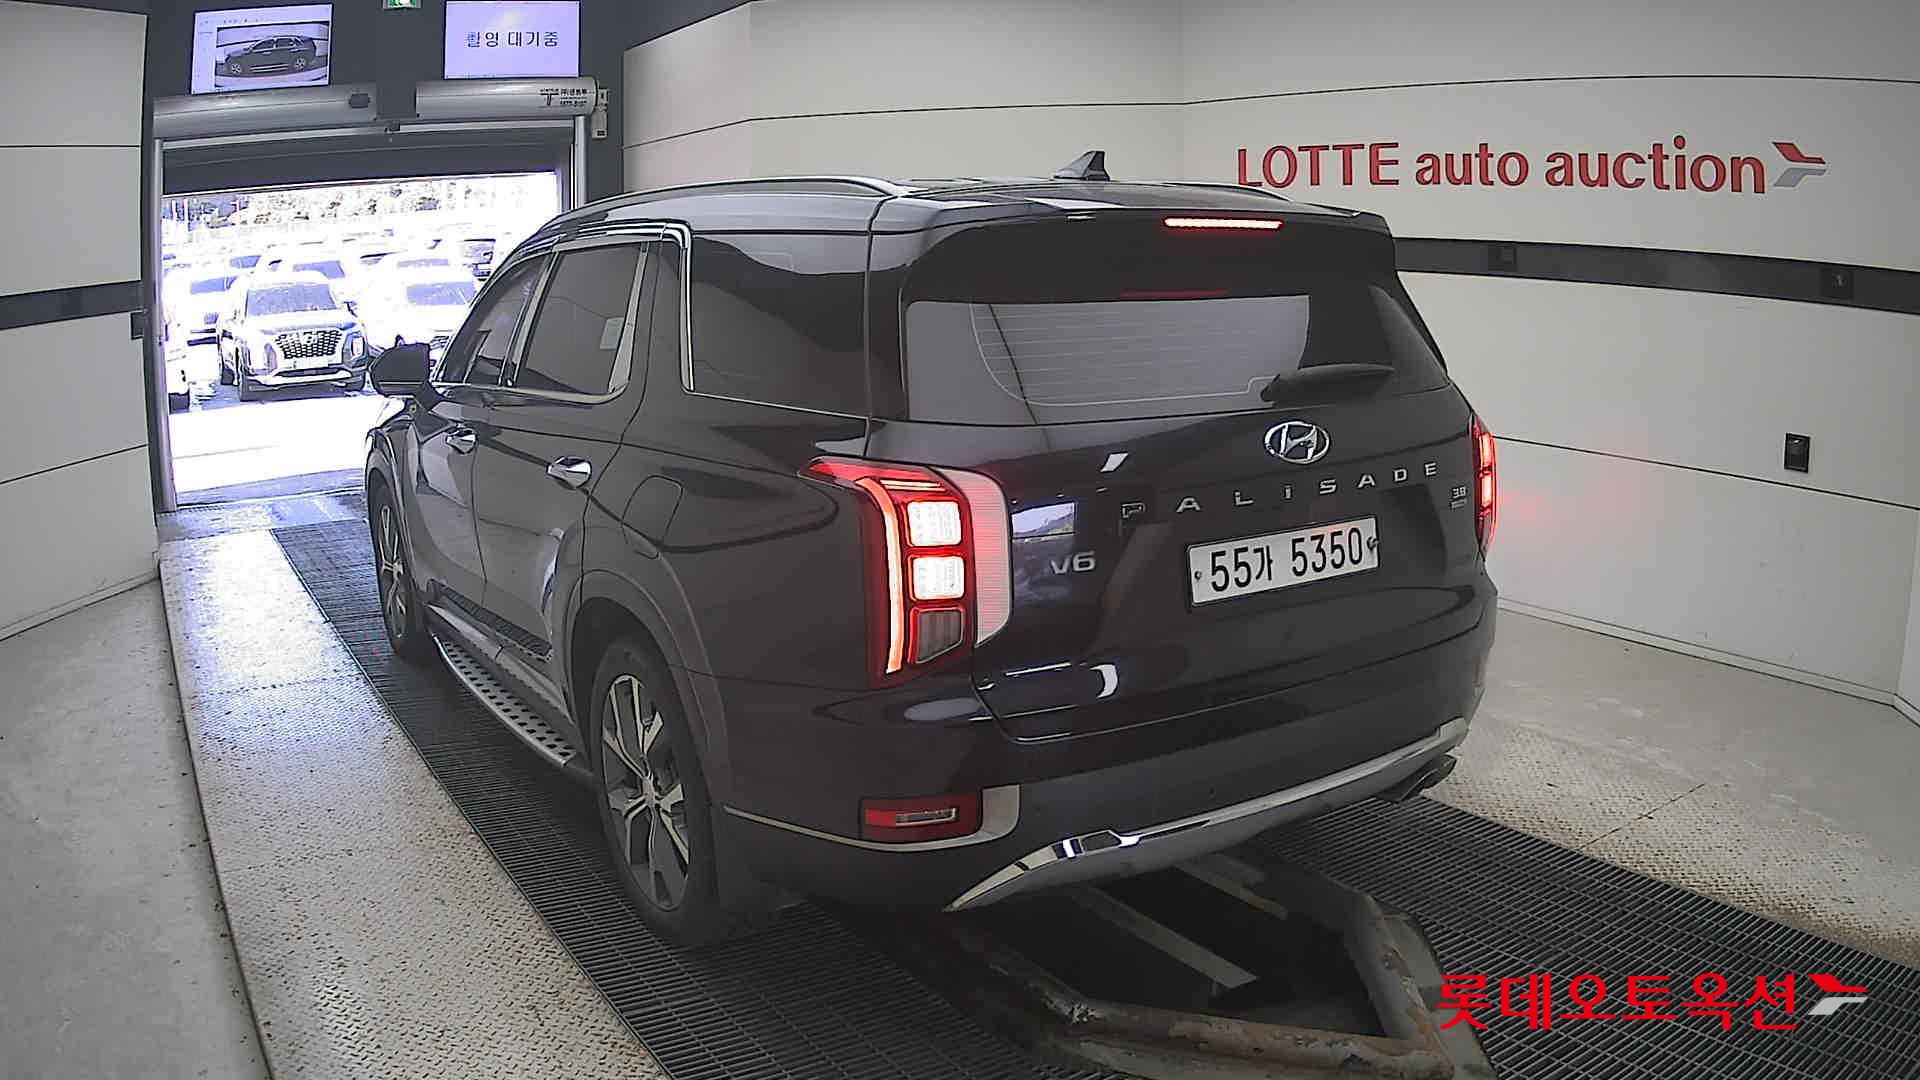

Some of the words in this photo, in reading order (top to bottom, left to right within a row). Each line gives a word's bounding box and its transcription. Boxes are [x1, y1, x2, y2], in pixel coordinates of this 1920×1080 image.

[507, 31, 559, 48] 대기중
[1237, 141, 1400, 189] LOTTE
[1414, 142, 1530, 188] auto
[1544, 135, 1767, 195] auction
[1121, 461, 1439, 519] PALISADE
[1050, 551, 1096, 574] V6
[1210, 545, 1273, 592] 55가
[1291, 527, 1363, 577] 5350
